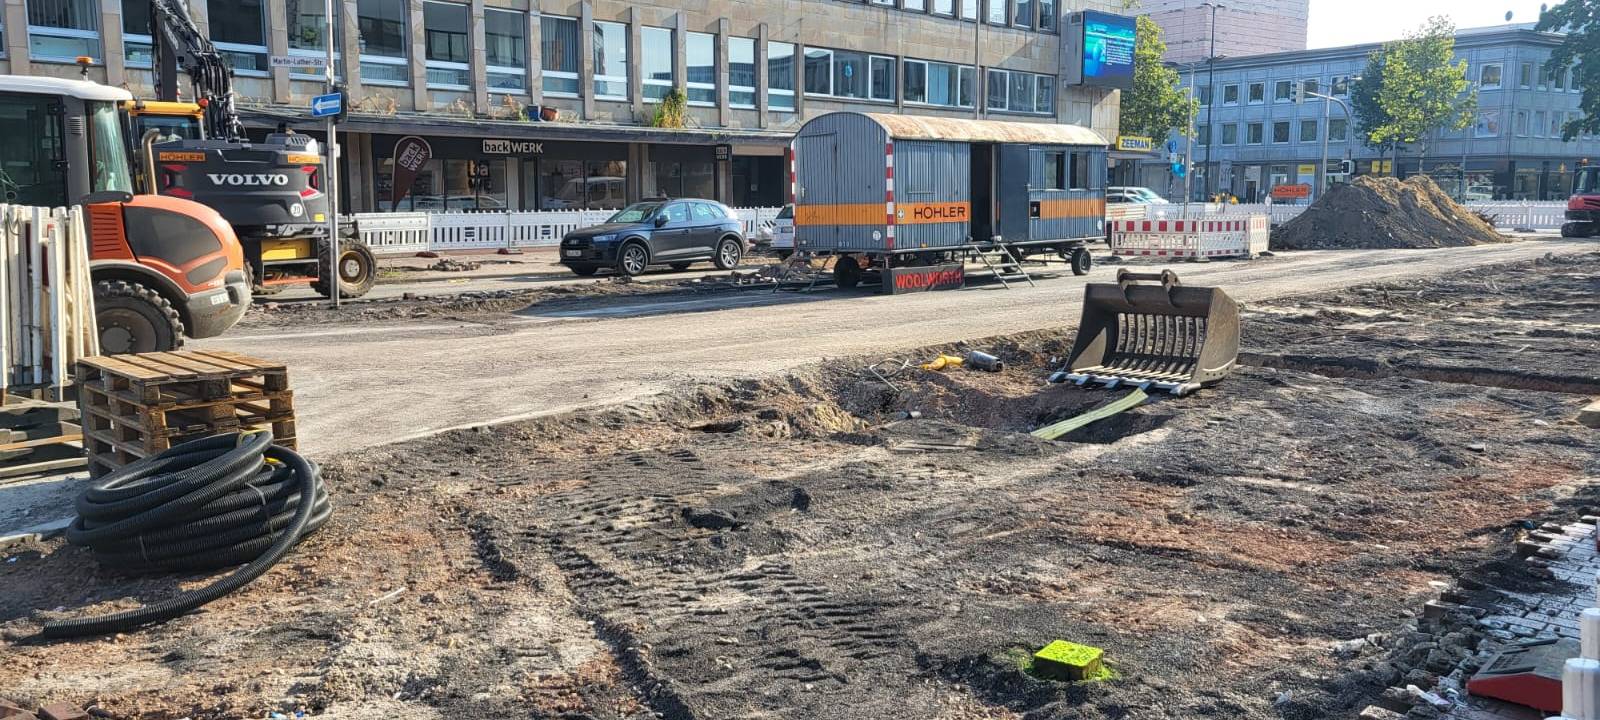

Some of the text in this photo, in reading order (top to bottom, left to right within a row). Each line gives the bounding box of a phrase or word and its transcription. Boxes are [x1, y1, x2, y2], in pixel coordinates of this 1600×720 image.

[1120, 138, 1149, 149] ZEEMAN
[399, 142, 421, 168] back
[408, 148, 429, 172] WERK
[207, 173, 289, 186] VOLVO
[895, 270, 963, 289] WOOLWORTH
